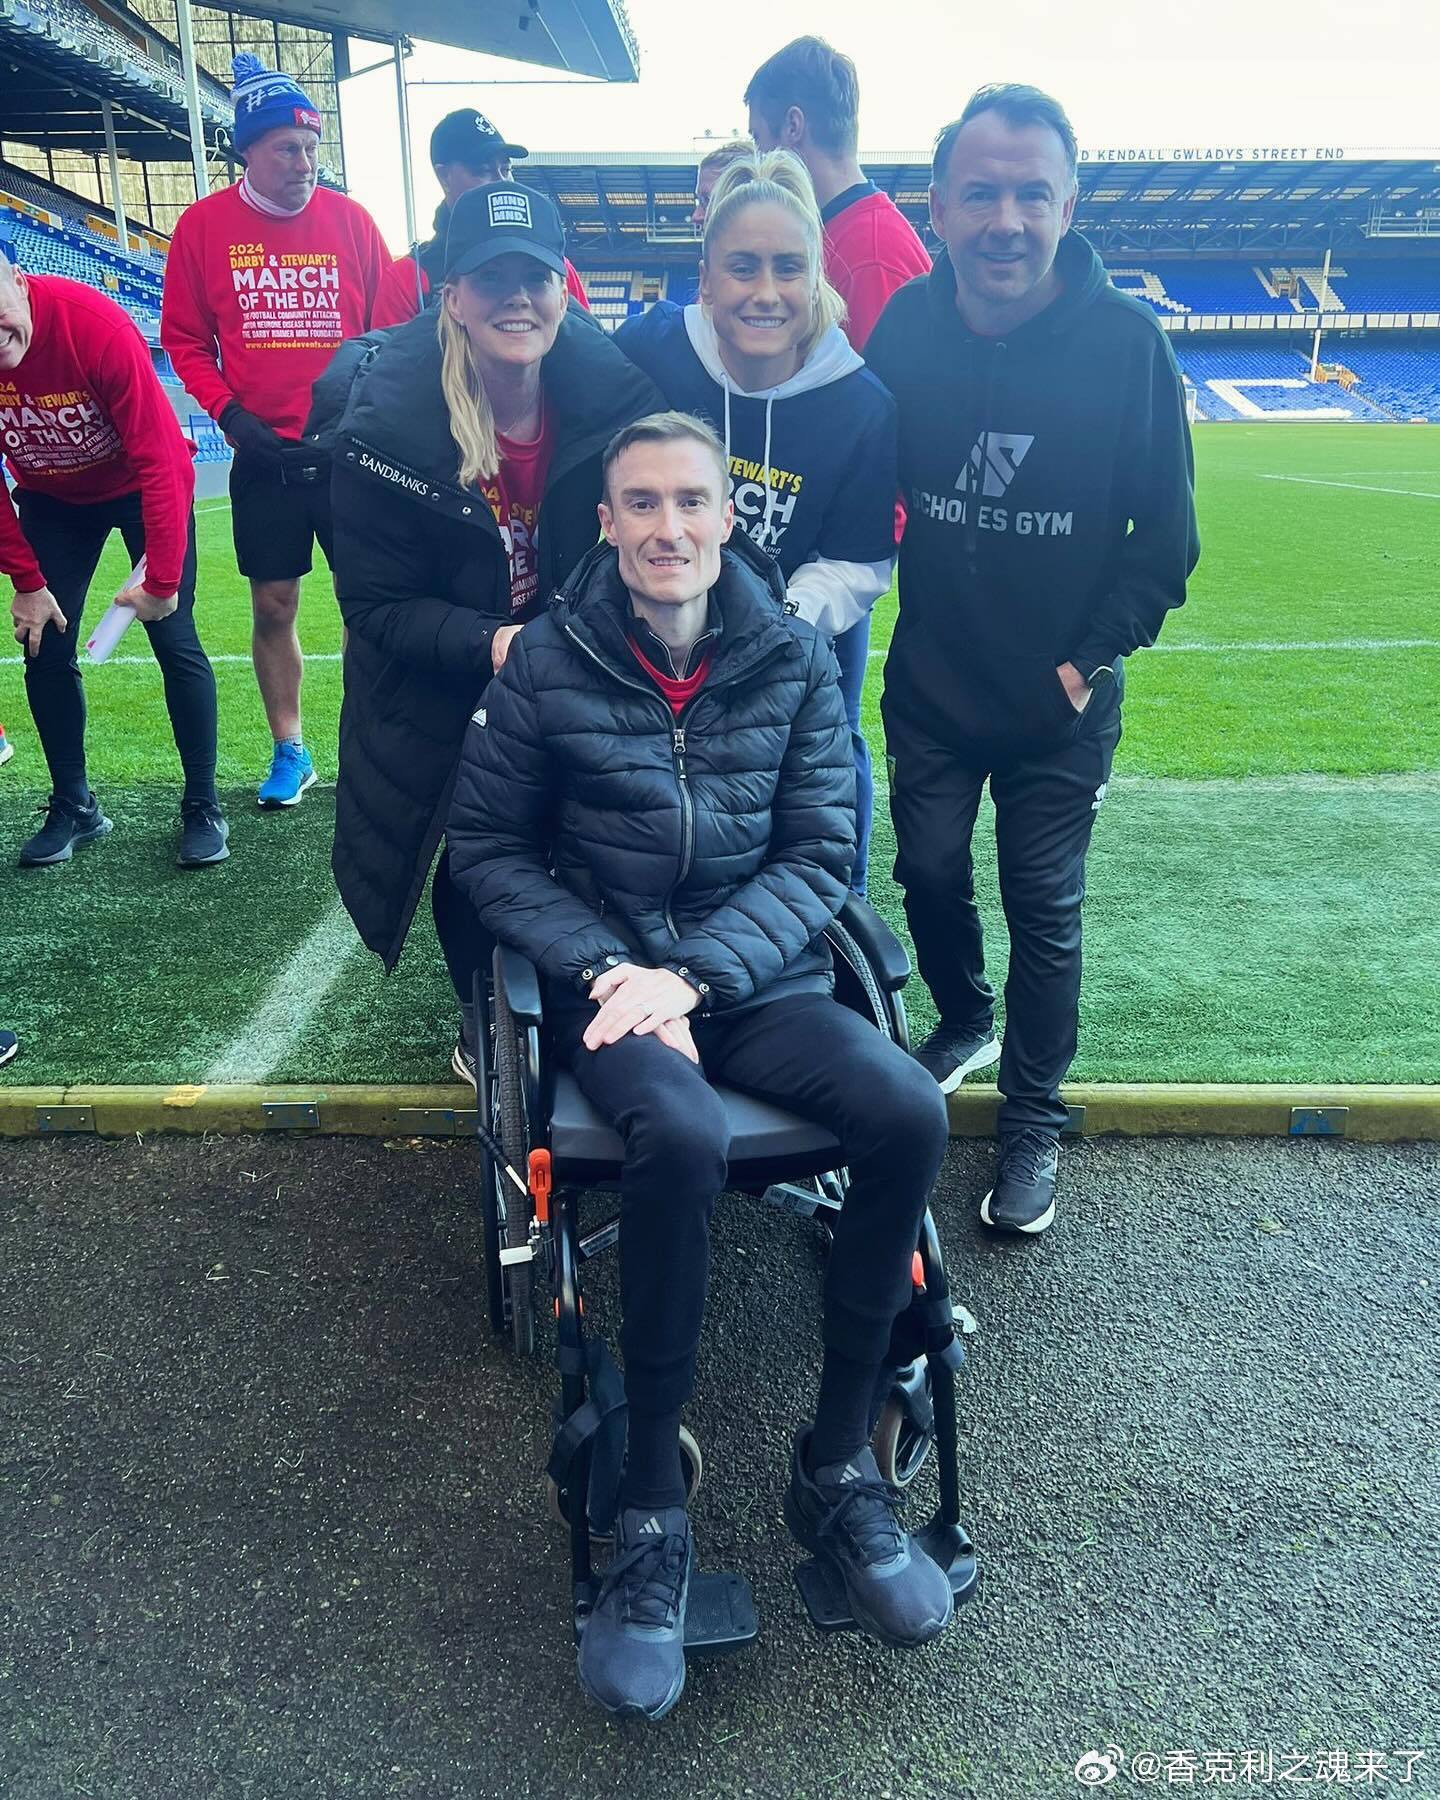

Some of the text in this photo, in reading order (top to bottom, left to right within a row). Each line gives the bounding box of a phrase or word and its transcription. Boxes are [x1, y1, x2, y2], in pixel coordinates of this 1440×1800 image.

[1098, 149, 1164, 160] KENDALL
[1173, 148, 1243, 160] GWLADYS
[1252, 148, 1307, 159] STREET
[1315, 148, 1344, 159] END
[492, 195, 526, 207] MIND
[494, 211, 527, 222] MND.
[229, 244, 264, 255] 2024
[230, 254, 337, 269] DARBY & STEWART'S
[232, 266, 339, 291] MARCH
[238, 291, 339, 310] OF THE DAY
[277, 311, 311, 319] COMMUNITY
[282, 320, 304, 328] DISEASE
[305, 320, 311, 328] IN
[312, 320, 335, 328] SUPPORT
[0, 400, 102, 431] MARCH
[5, 429, 28, 448] OF
[67, 415, 104, 445] DAY
[359, 453, 428, 496] SANDBANKS
[511, 502, 541, 526] STE
[1015, 512, 1073, 536] GYM
